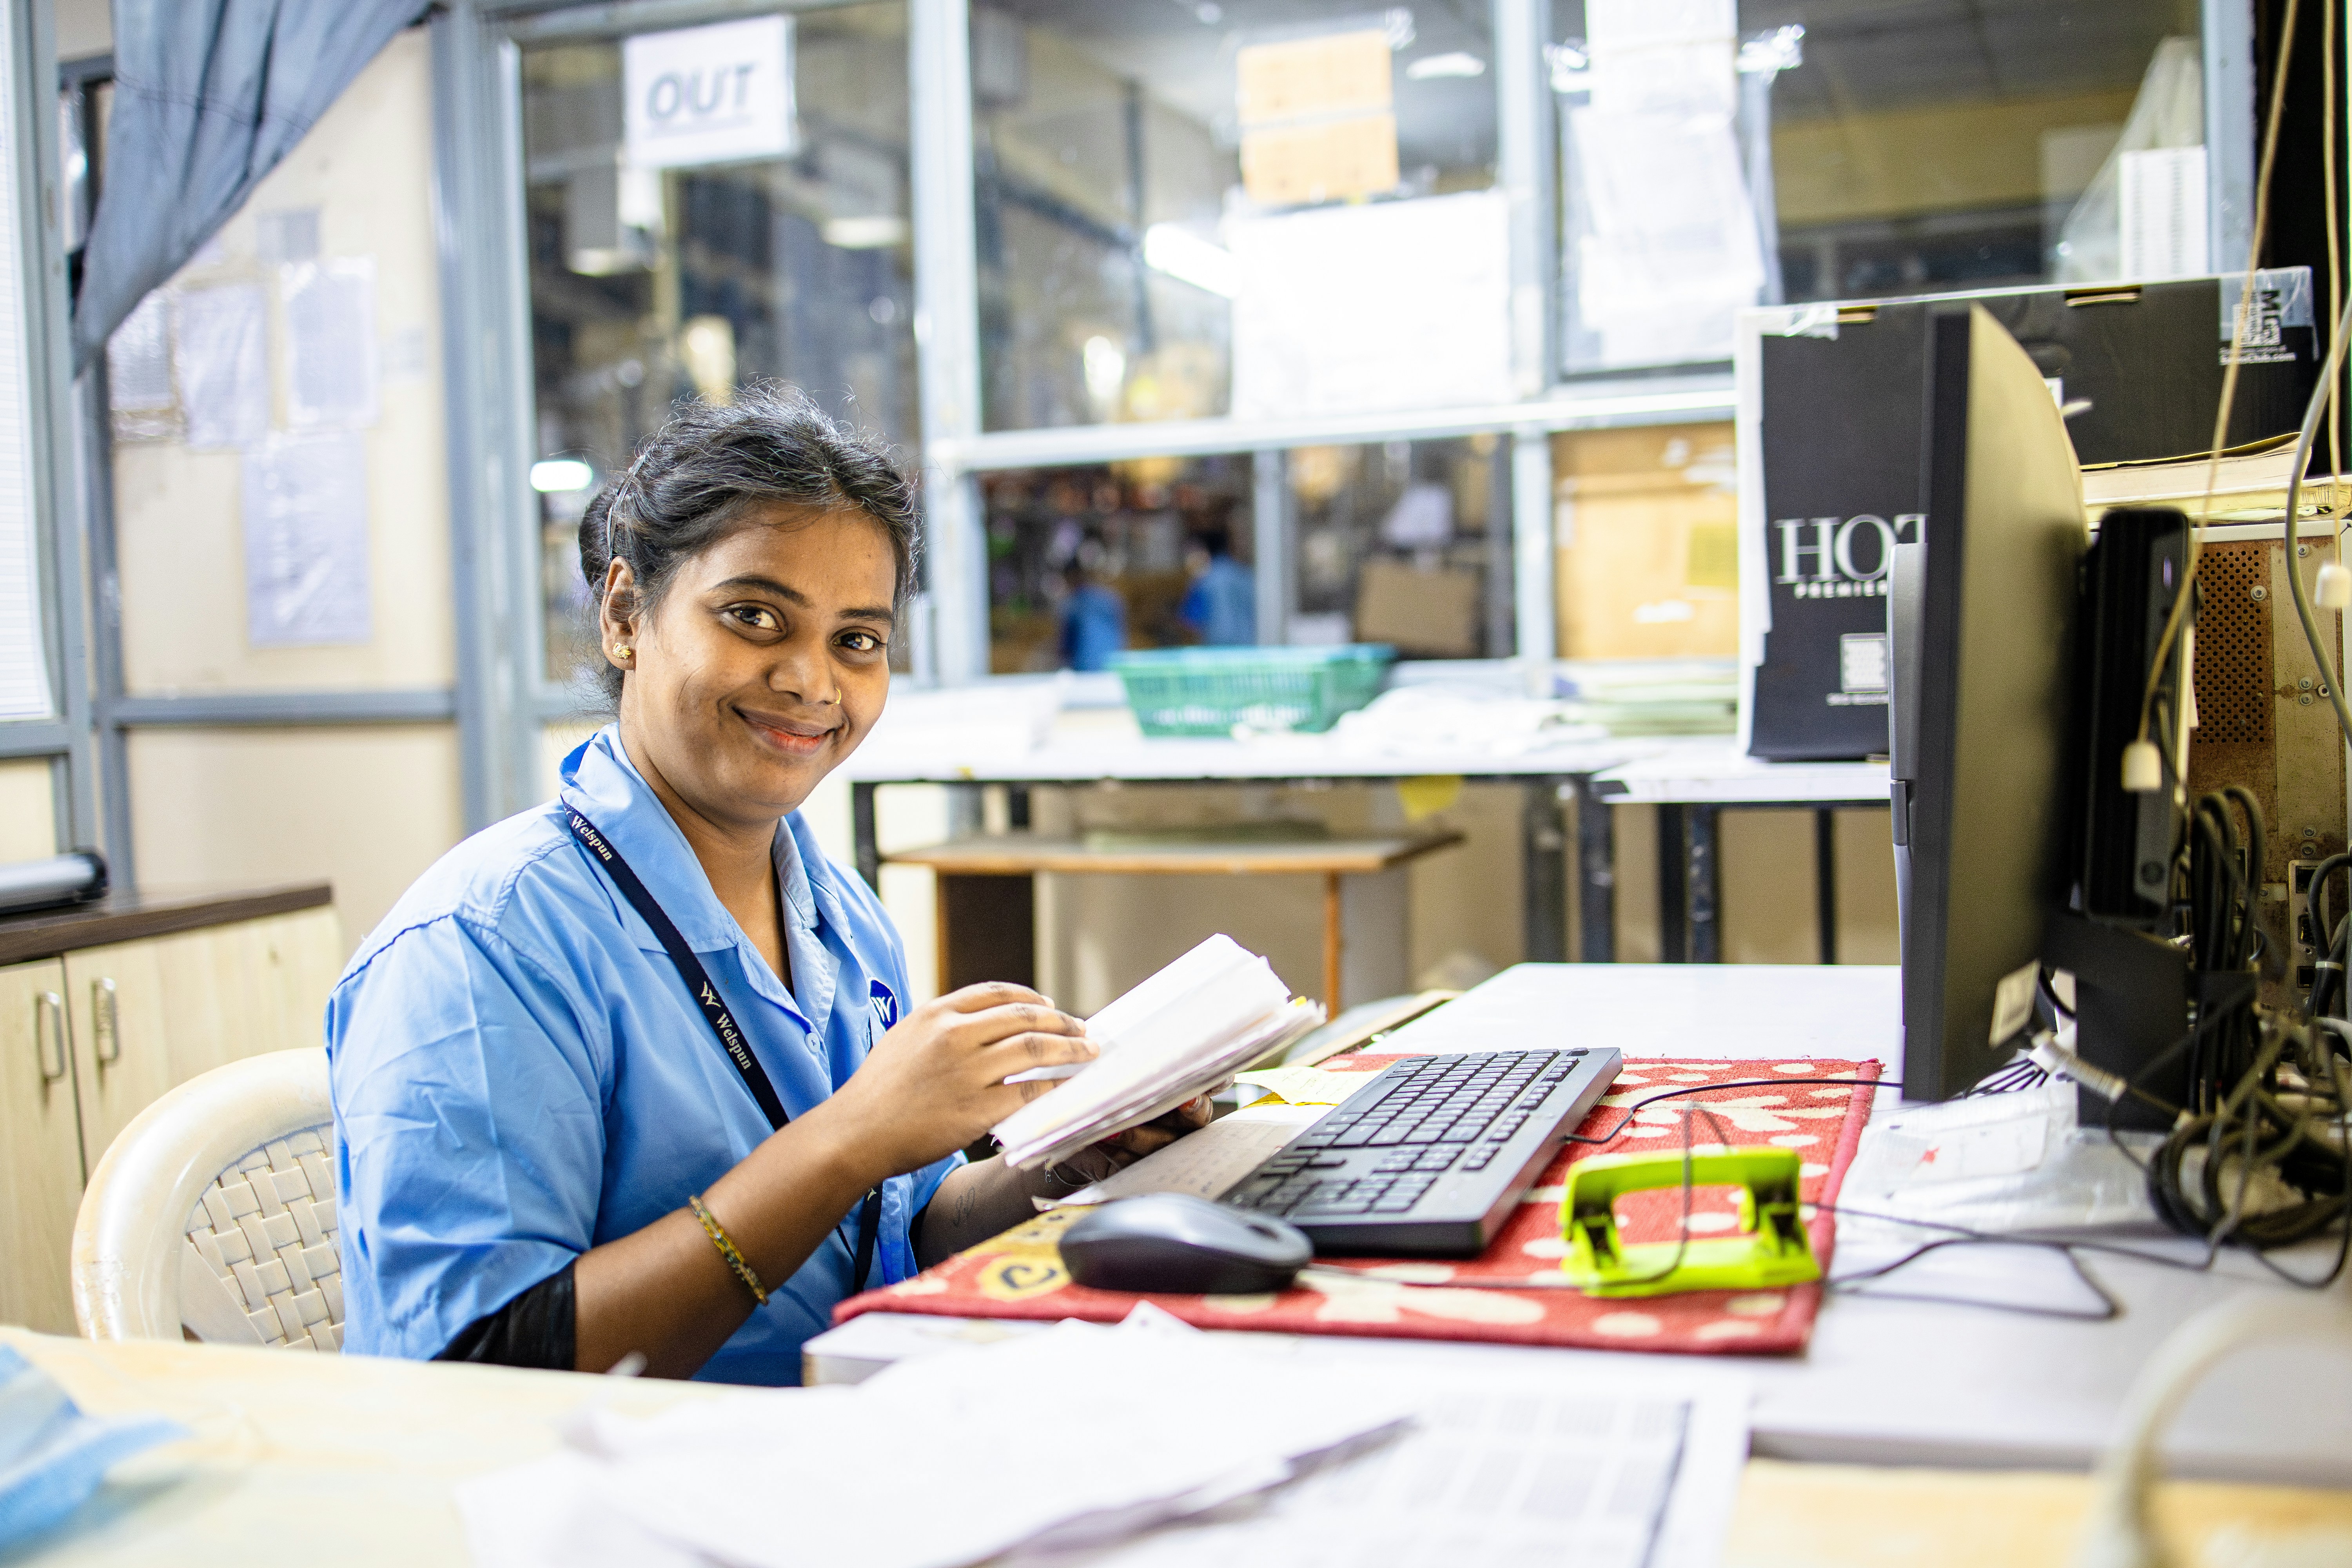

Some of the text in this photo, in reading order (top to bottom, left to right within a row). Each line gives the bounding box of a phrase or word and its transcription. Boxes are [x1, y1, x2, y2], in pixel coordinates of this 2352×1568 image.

[646, 63, 757, 122] OUT
[572, 815, 612, 861] Welspun
[717, 1013, 751, 1070] Welspun
